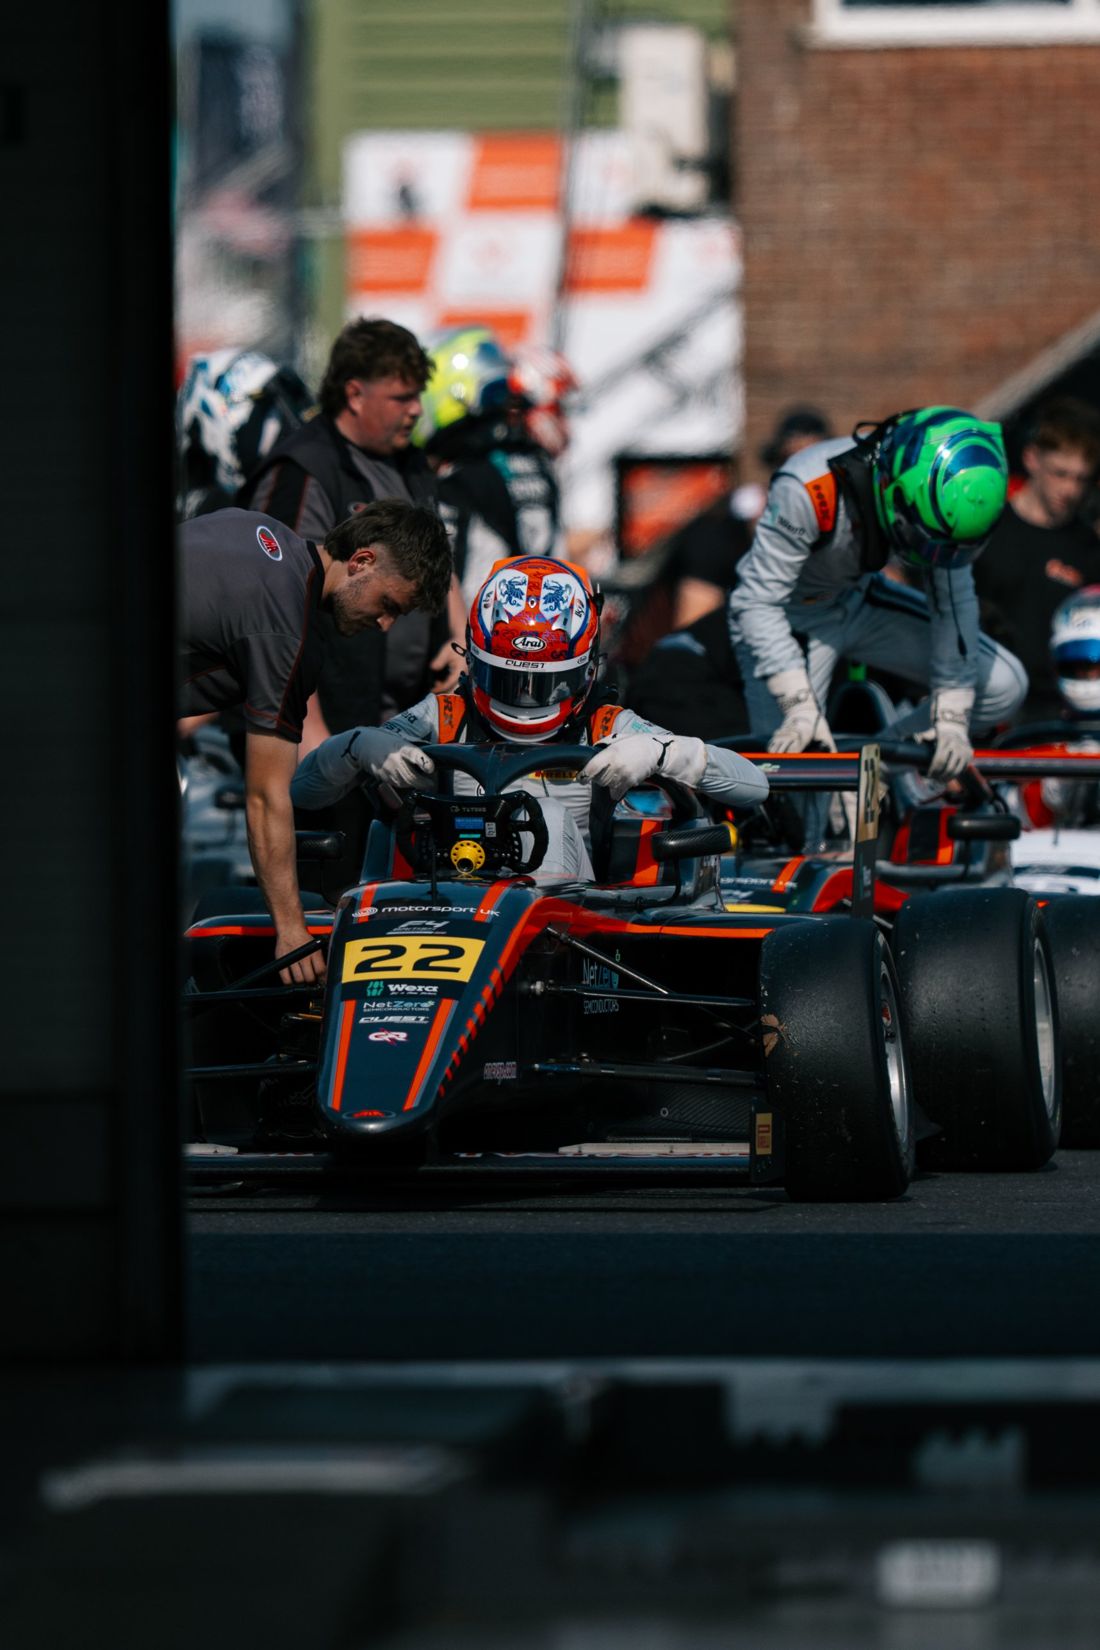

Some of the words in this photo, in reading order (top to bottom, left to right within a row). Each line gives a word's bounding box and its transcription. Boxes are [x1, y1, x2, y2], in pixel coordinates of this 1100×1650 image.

[515, 637, 541, 648] Arai
[505, 659, 545, 669] QUEST
[381, 905, 477, 915] motorsport
[480, 909, 501, 917] UK
[397, 920, 450, 931] F4
[354, 944, 465, 974] 22
[387, 984, 439, 993] Wera
[363, 1001, 430, 1009] NetZero
[359, 1015, 430, 1024] QUEST
